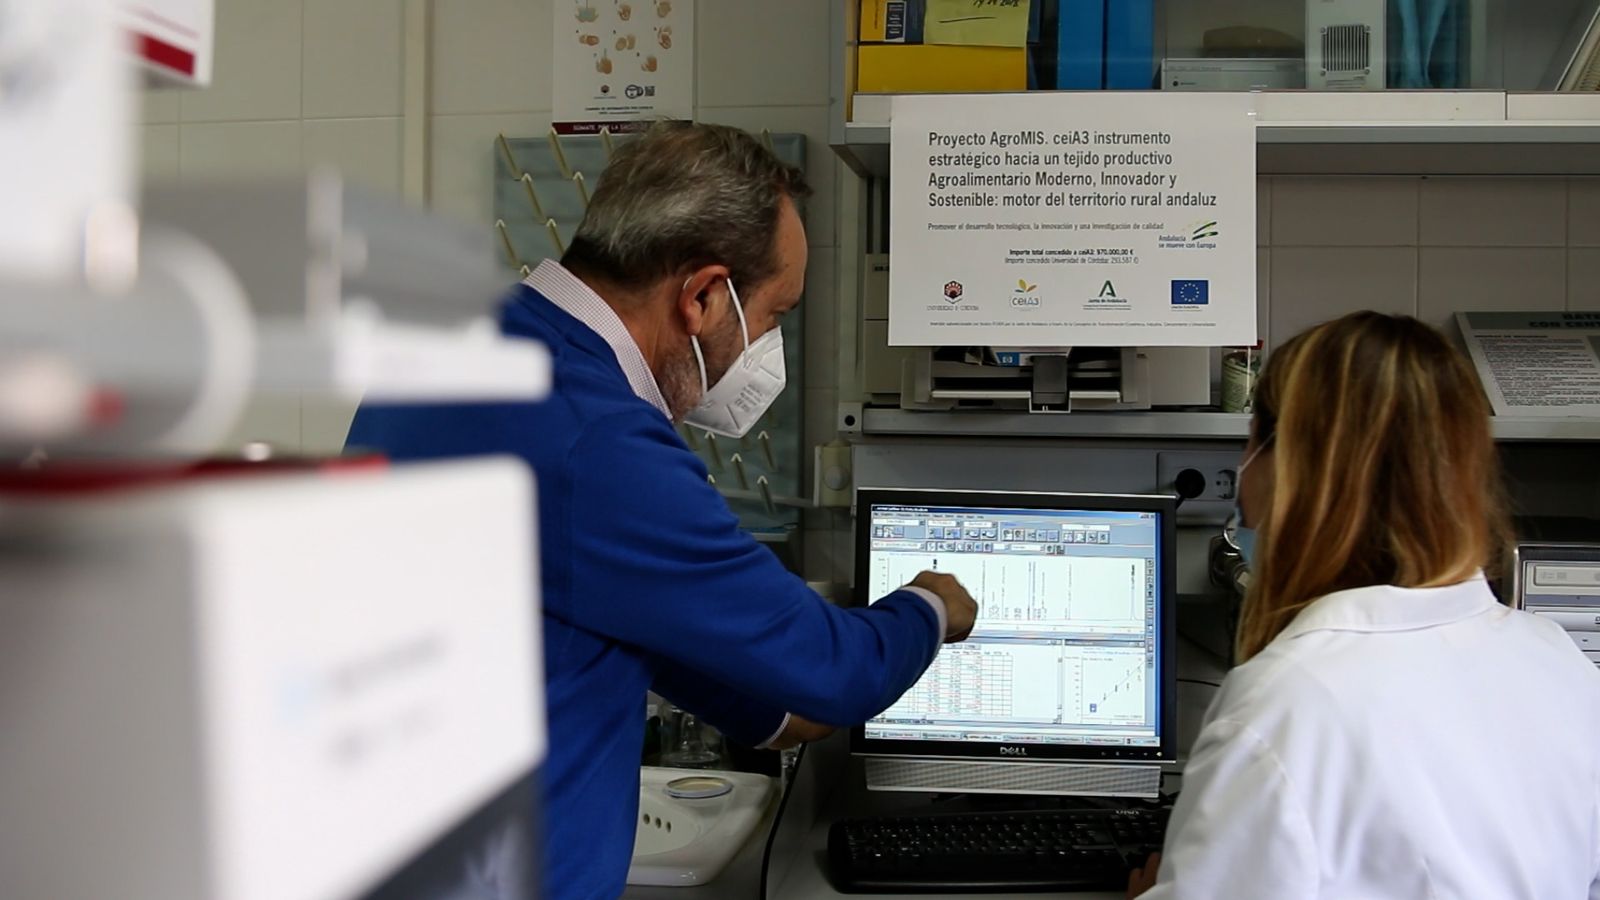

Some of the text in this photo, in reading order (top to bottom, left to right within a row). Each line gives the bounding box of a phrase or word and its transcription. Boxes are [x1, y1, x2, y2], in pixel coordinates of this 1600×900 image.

[928, 131, 1171, 149] Proyecto AgroMIS. ceiA3 instrumento
[928, 151, 1172, 169] estratégico hacia un tejido productivo
[928, 171, 1177, 189] Agroalimentario Moderno, Innovador y
[928, 192, 1217, 207] Sostenible: motor del territorio rural andaluz
[1010, 249, 1030, 257] Importe
[1000, 746, 1028, 755] DELL
